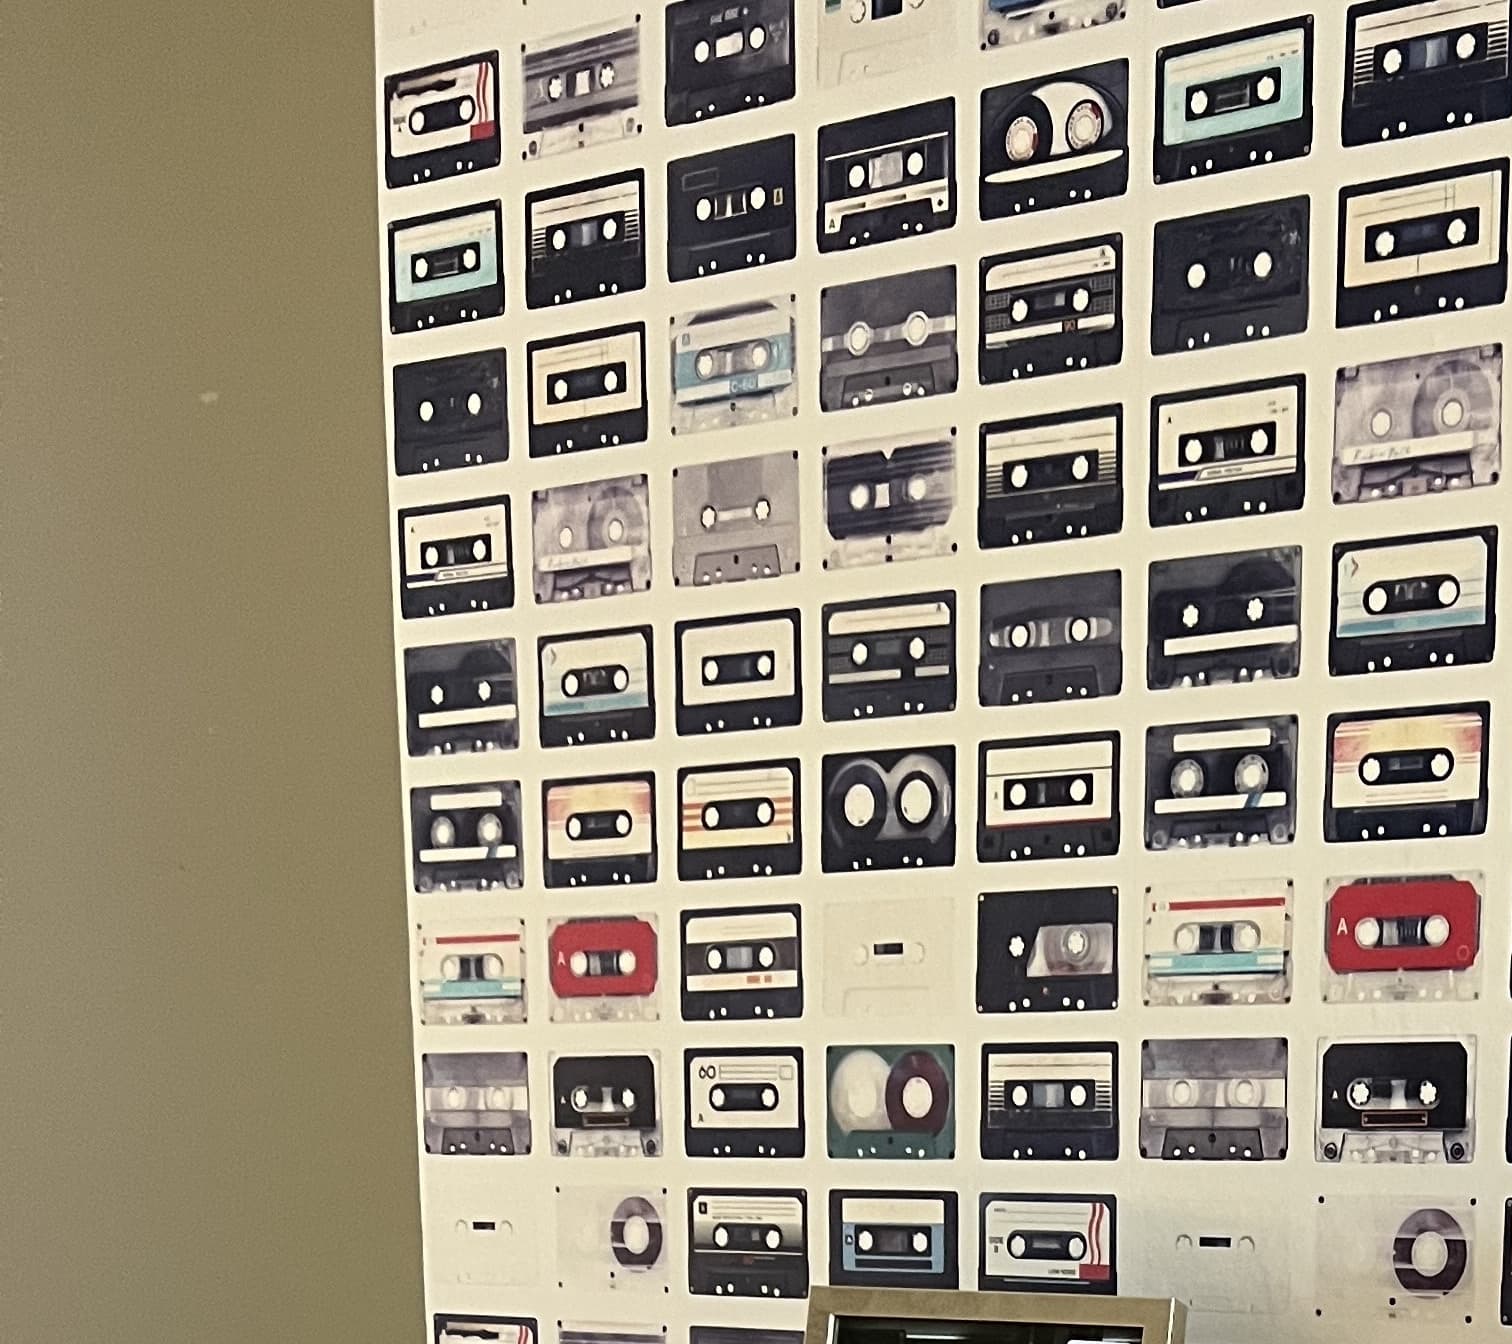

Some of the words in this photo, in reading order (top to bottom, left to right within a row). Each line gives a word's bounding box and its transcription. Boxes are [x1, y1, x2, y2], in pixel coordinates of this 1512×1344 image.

[829, 218, 836, 230] A
[1336, 917, 1348, 936] A
[559, 951, 566, 966] A
[698, 1065, 716, 1079] 60
[1332, 1089, 1338, 1099] A
